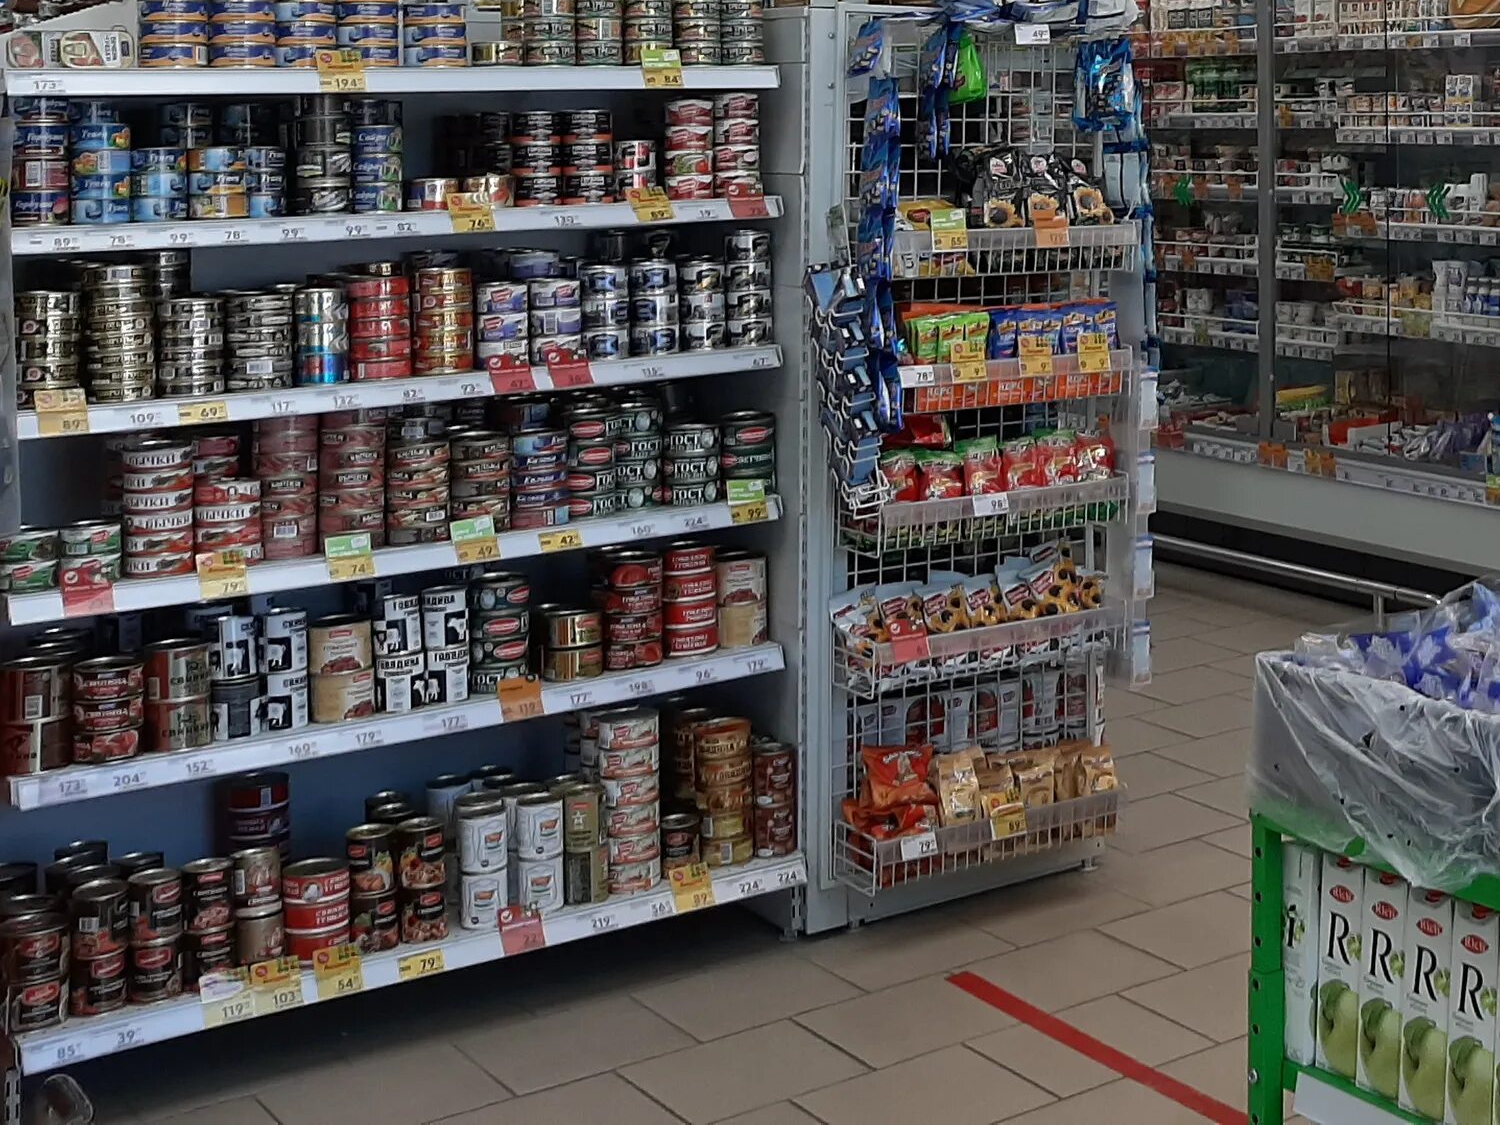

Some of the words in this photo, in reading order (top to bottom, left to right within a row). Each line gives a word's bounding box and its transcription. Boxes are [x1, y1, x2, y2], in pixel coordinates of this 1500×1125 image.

[1328, 912, 1350, 965] R
[1369, 928, 1393, 984] R
[1414, 945, 1437, 1002] R
[1458, 962, 1484, 1021] R
